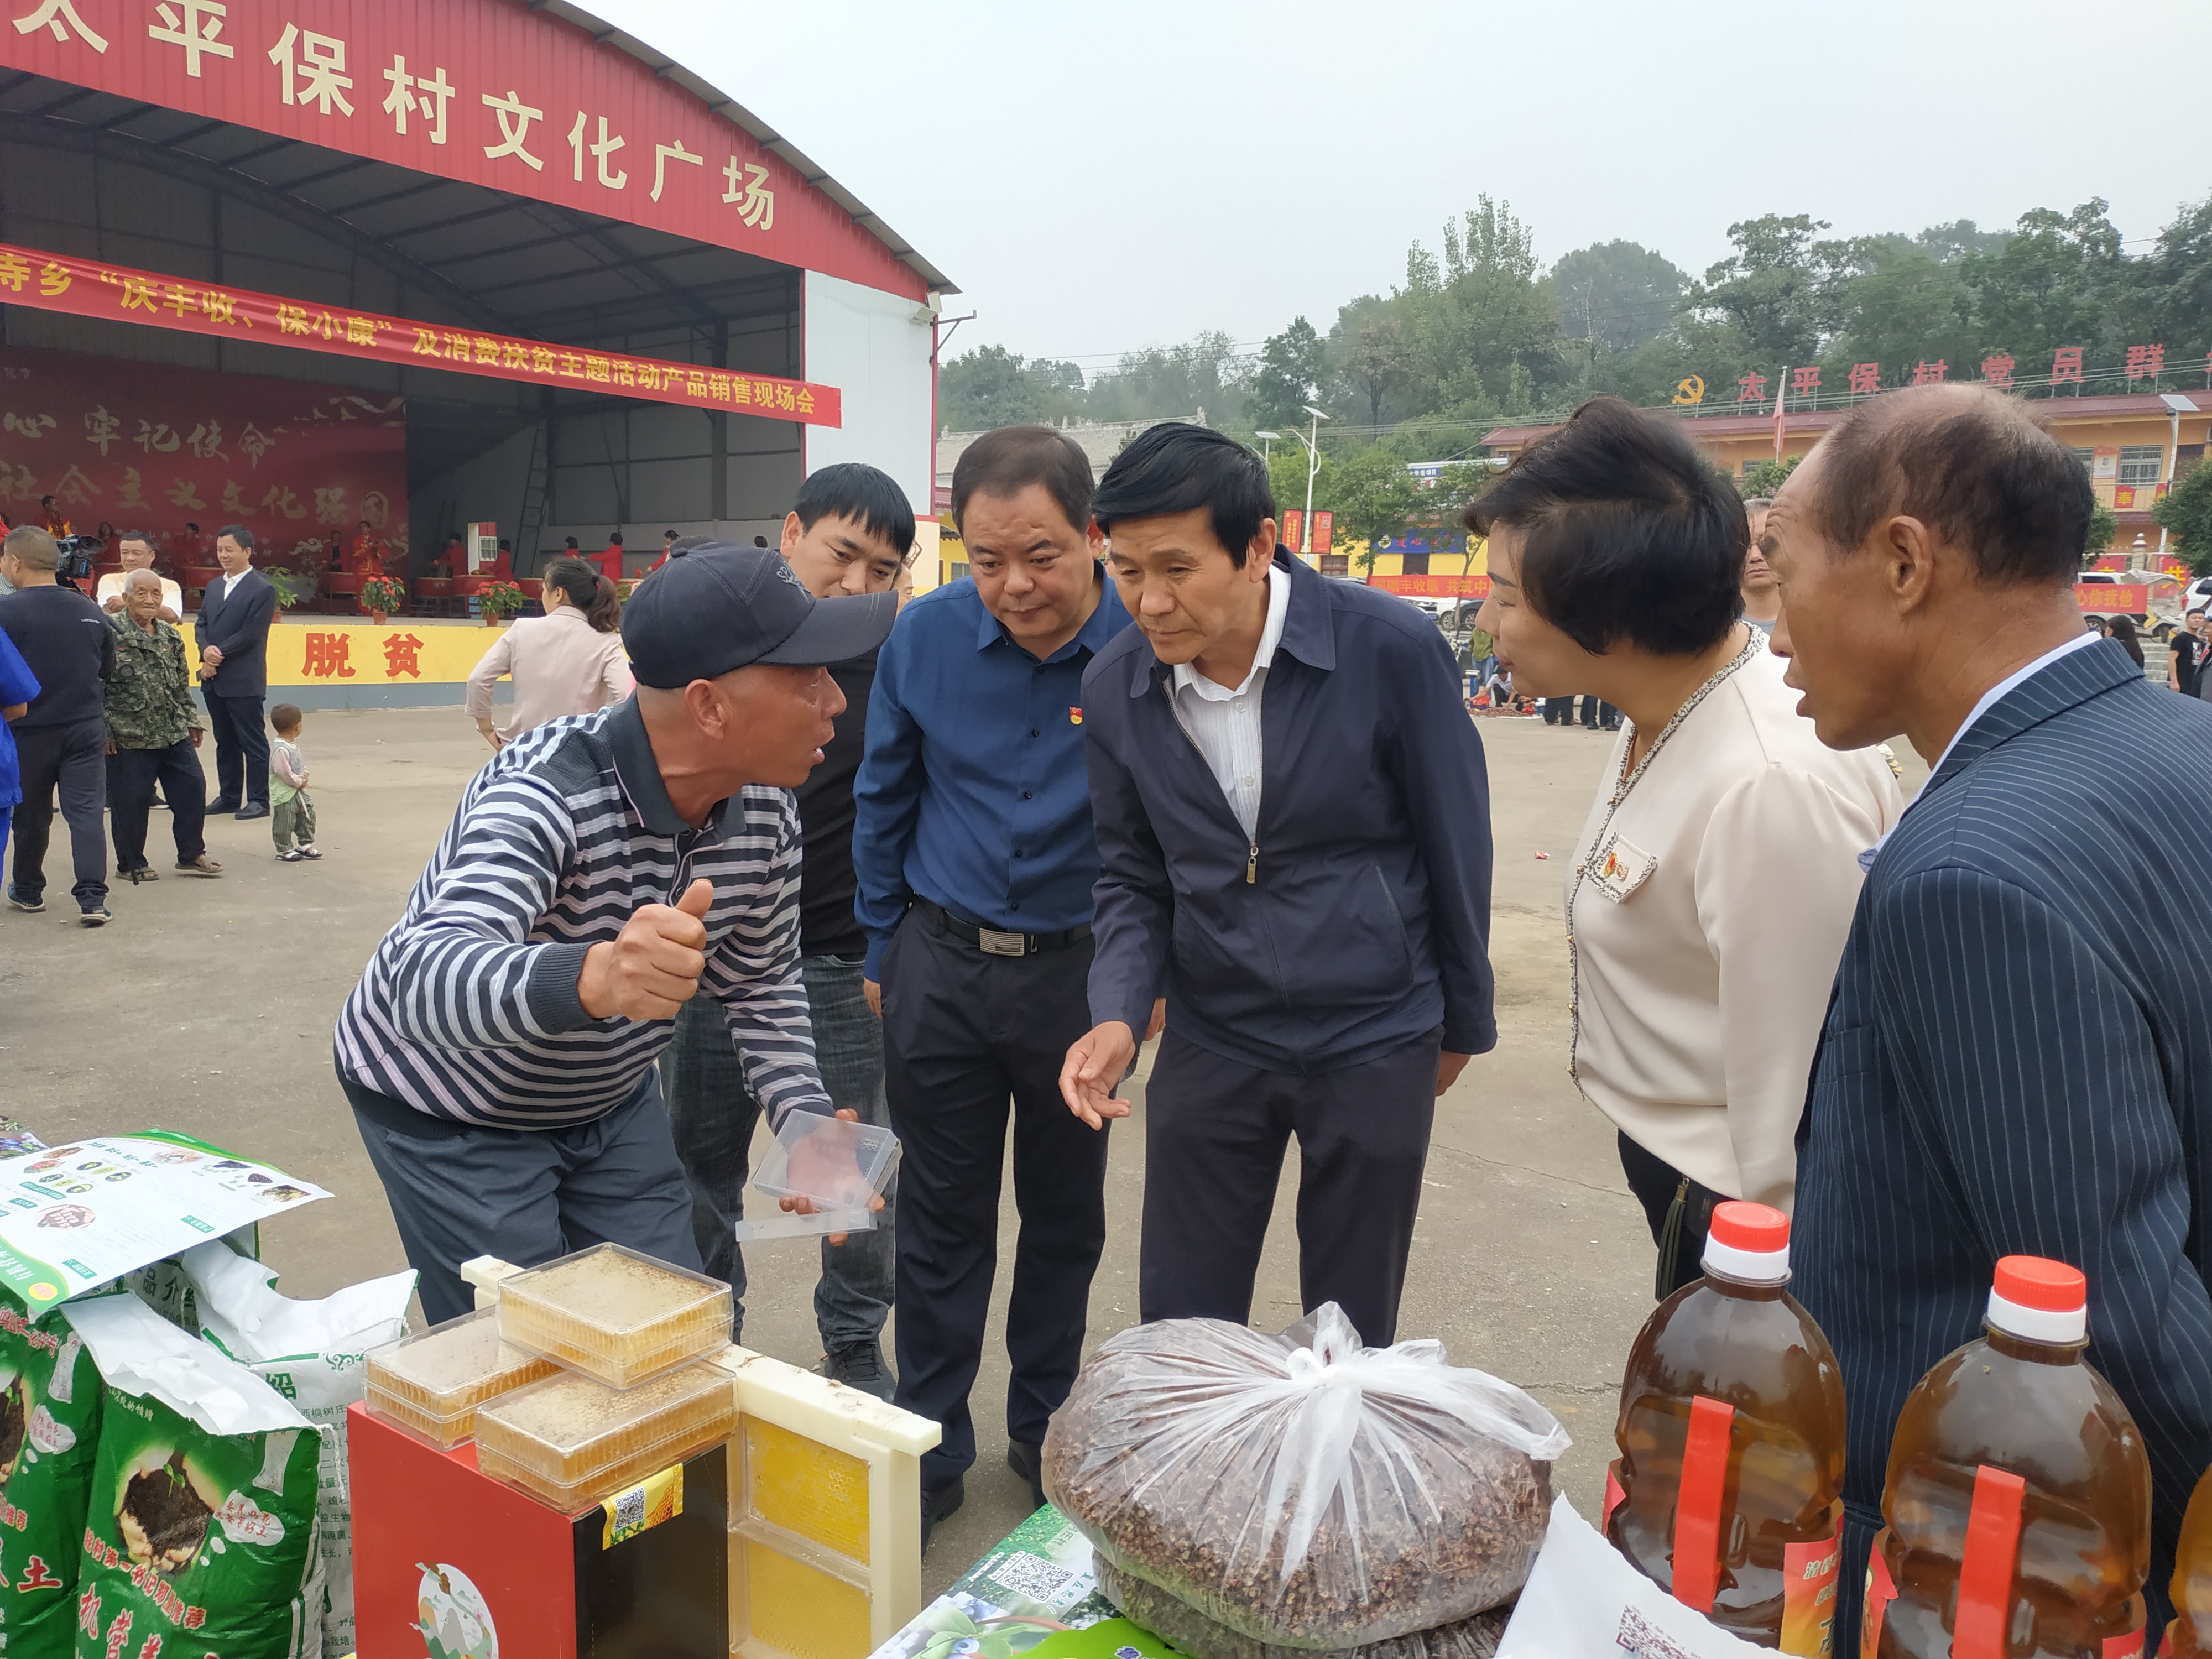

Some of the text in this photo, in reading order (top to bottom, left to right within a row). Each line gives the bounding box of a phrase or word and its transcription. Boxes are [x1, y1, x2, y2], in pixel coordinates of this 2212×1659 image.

[1737, 343, 2212, 402] 太平保村党员群
[1446, 580, 1493, 594] 共筑中
[301, 1402, 351, 1419] 西桐树庄
